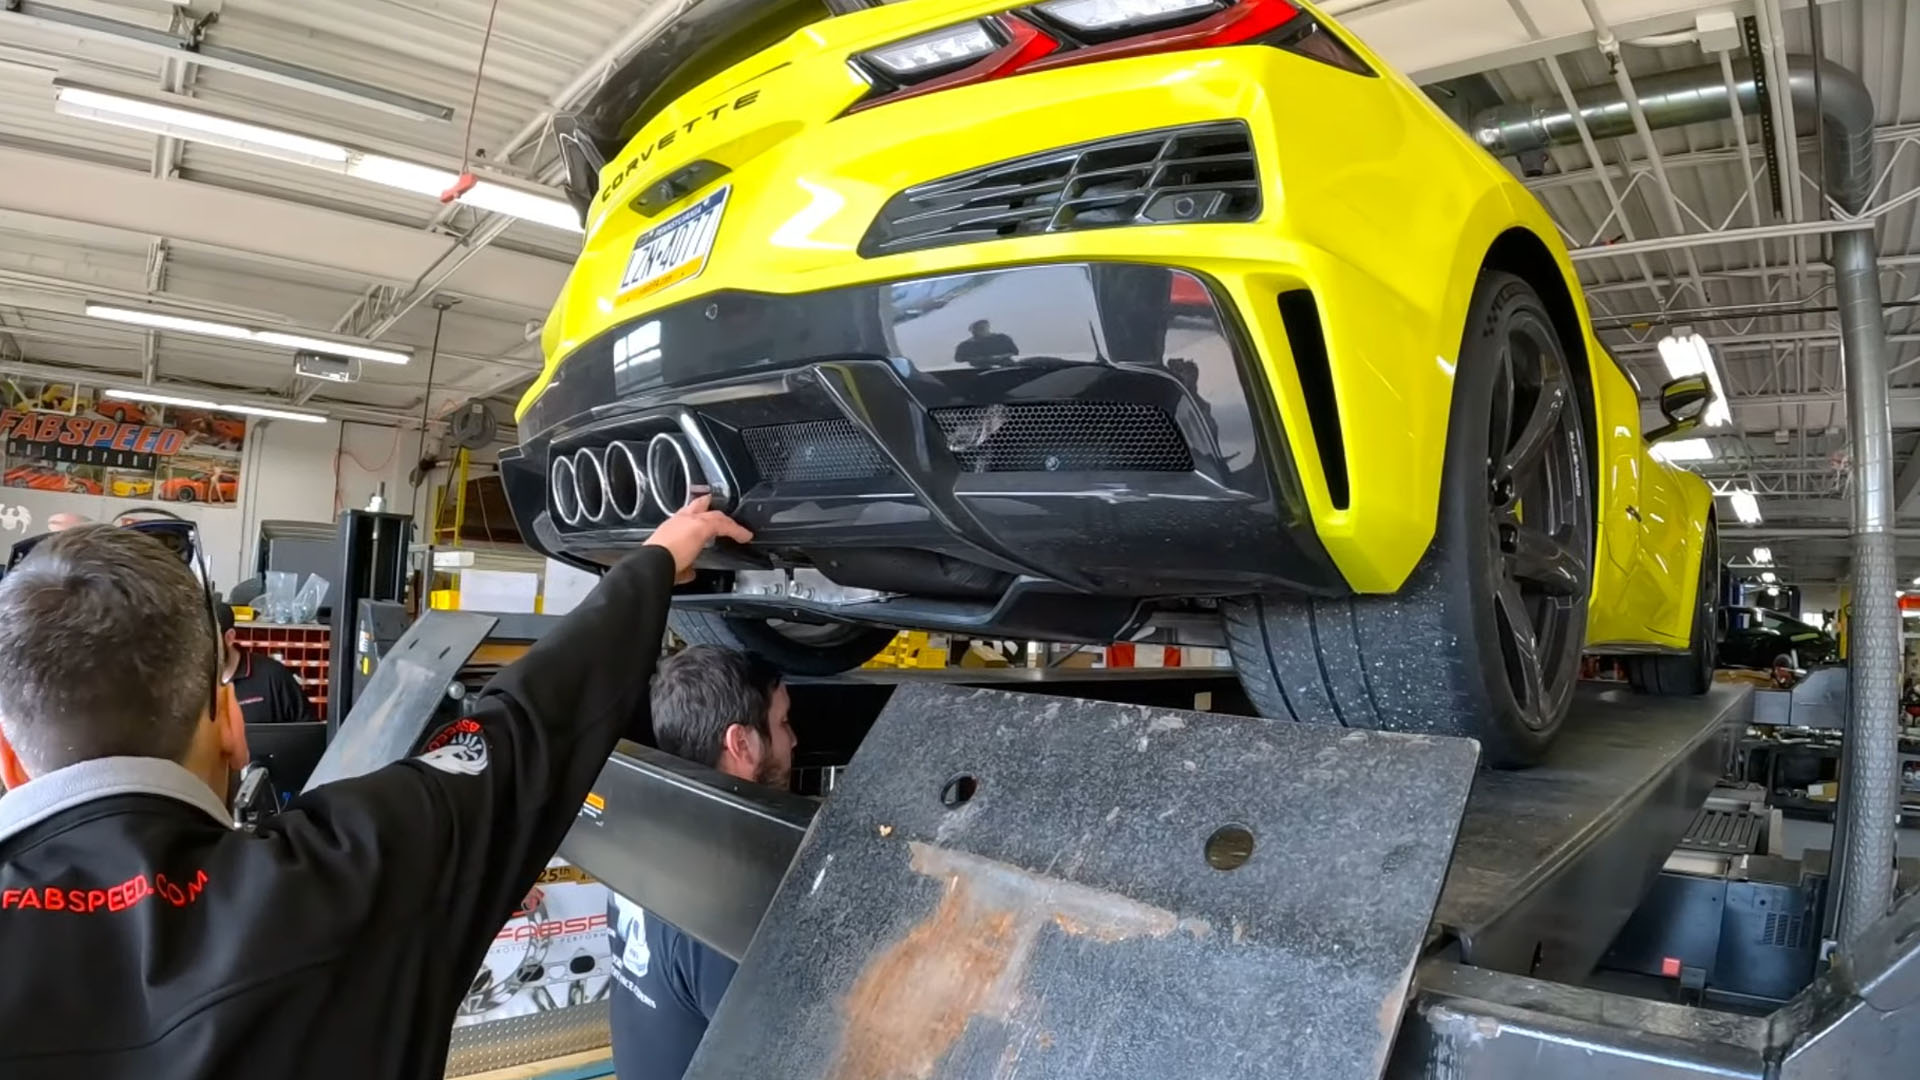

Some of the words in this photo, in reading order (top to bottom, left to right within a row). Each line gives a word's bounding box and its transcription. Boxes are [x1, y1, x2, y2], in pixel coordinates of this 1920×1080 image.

[601, 89, 761, 203] CORVETTE
[0, 408, 188, 456] FABSPEED
[495, 914, 607, 942] FABSP
